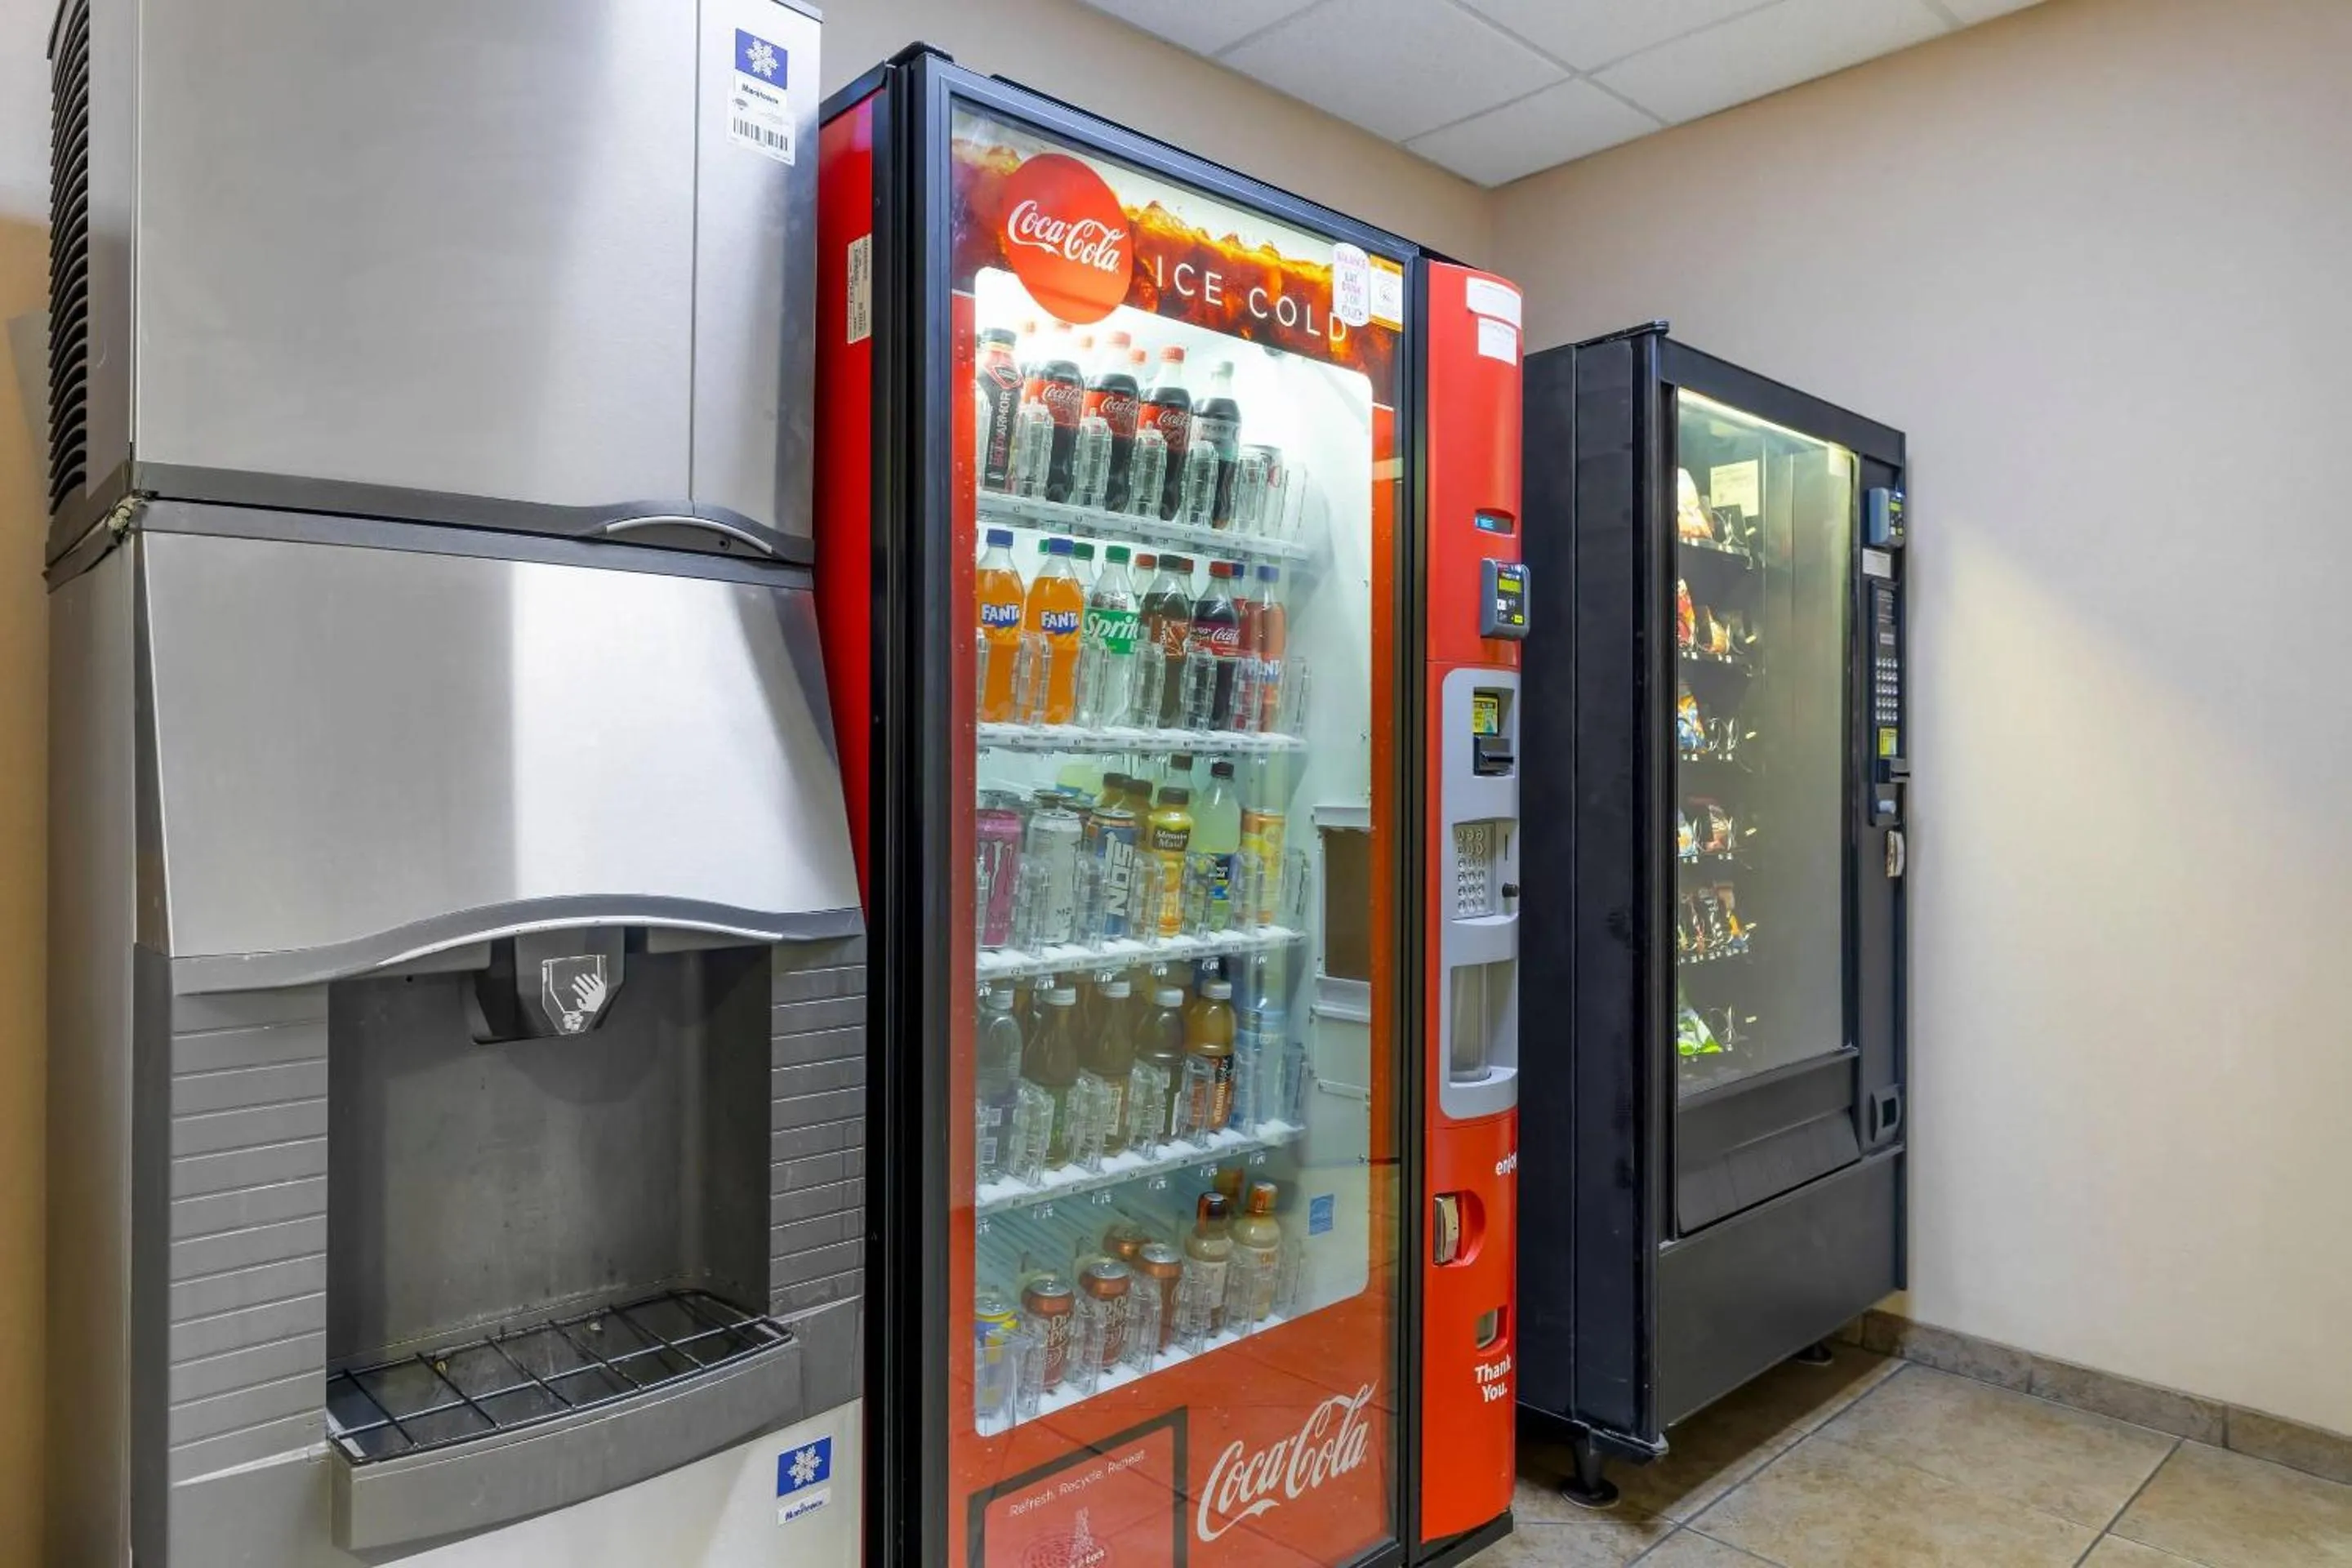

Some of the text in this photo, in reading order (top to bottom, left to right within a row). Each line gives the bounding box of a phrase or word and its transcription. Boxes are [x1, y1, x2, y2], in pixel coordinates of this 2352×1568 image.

[1008, 200, 1126, 273] Coca-Cola
[1157, 256, 1223, 305] ICE
[1249, 287, 1347, 341] COLD
[1495, 1152, 1517, 1176] enjo
[1474, 1354, 1511, 1384] Thank
[1482, 1383, 1508, 1402] You.
[1197, 1379, 1378, 1542] Coca-Cola
